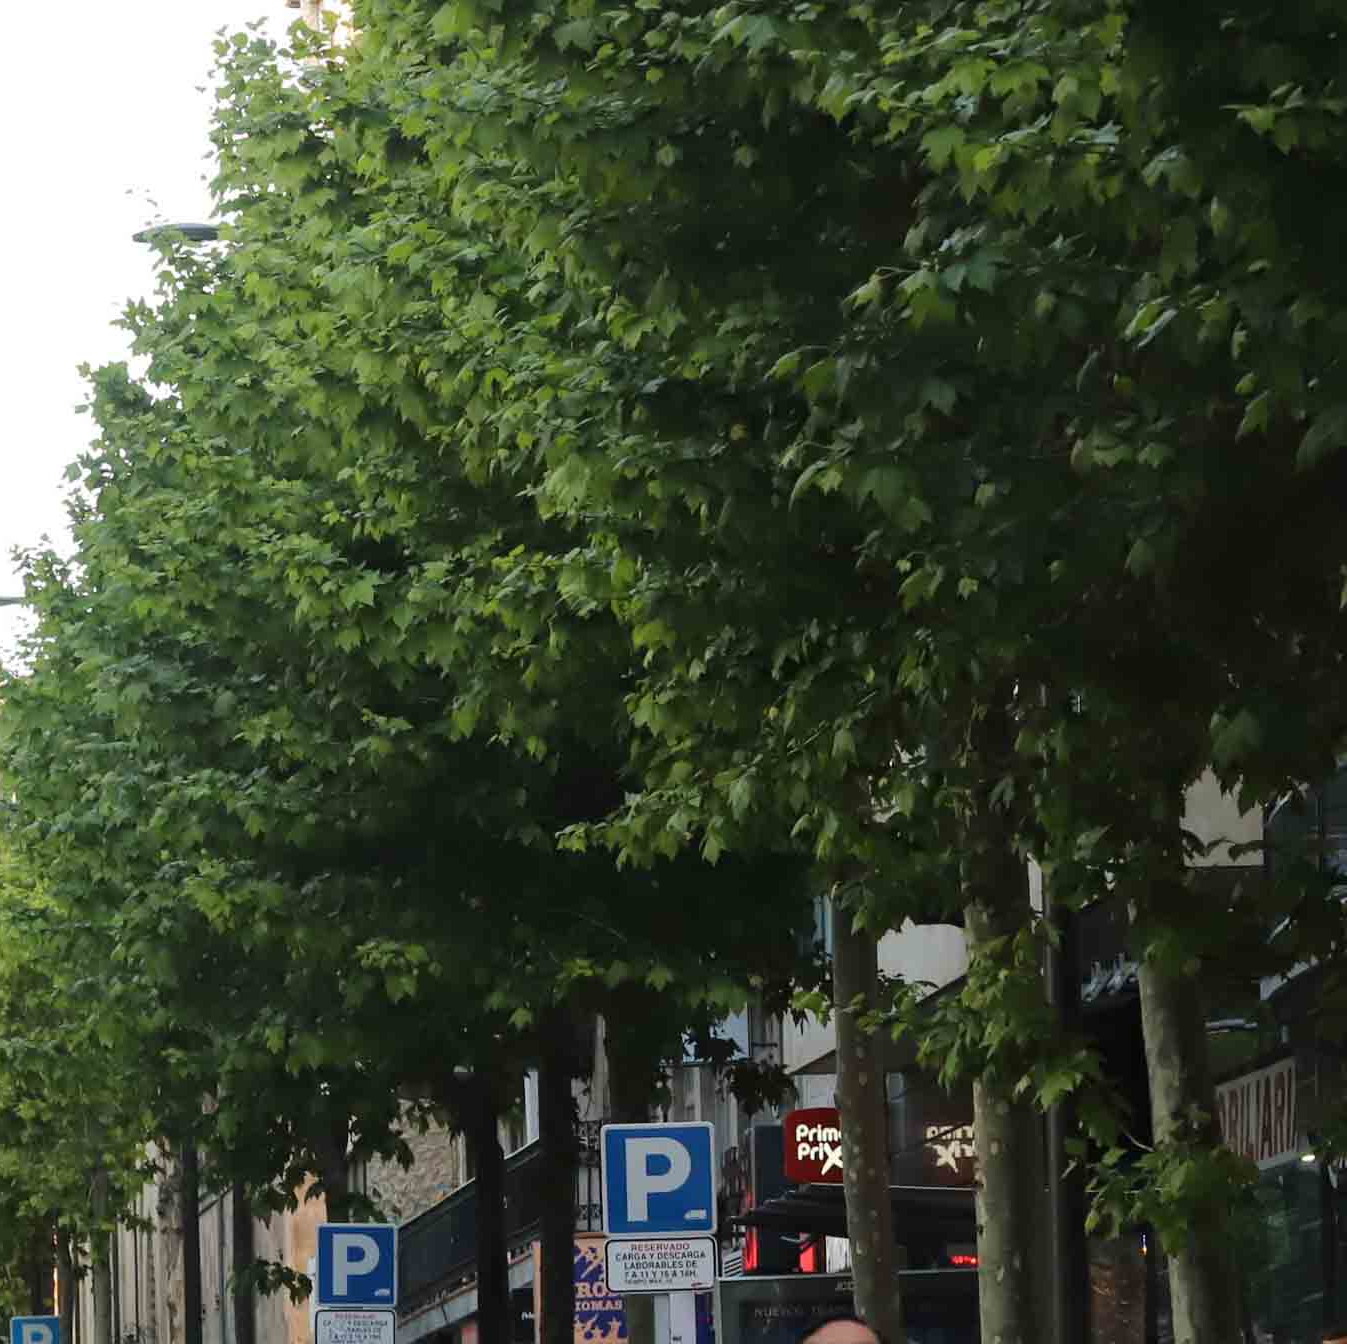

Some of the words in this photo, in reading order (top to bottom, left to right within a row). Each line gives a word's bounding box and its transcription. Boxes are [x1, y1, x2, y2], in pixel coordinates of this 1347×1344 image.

[795, 1123, 843, 1142] Prim
[625, 1137, 692, 1222] P
[332, 1233, 380, 1296] P
[615, 1252, 647, 1262] CARGA
[657, 1251, 707, 1260] DESCARGA
